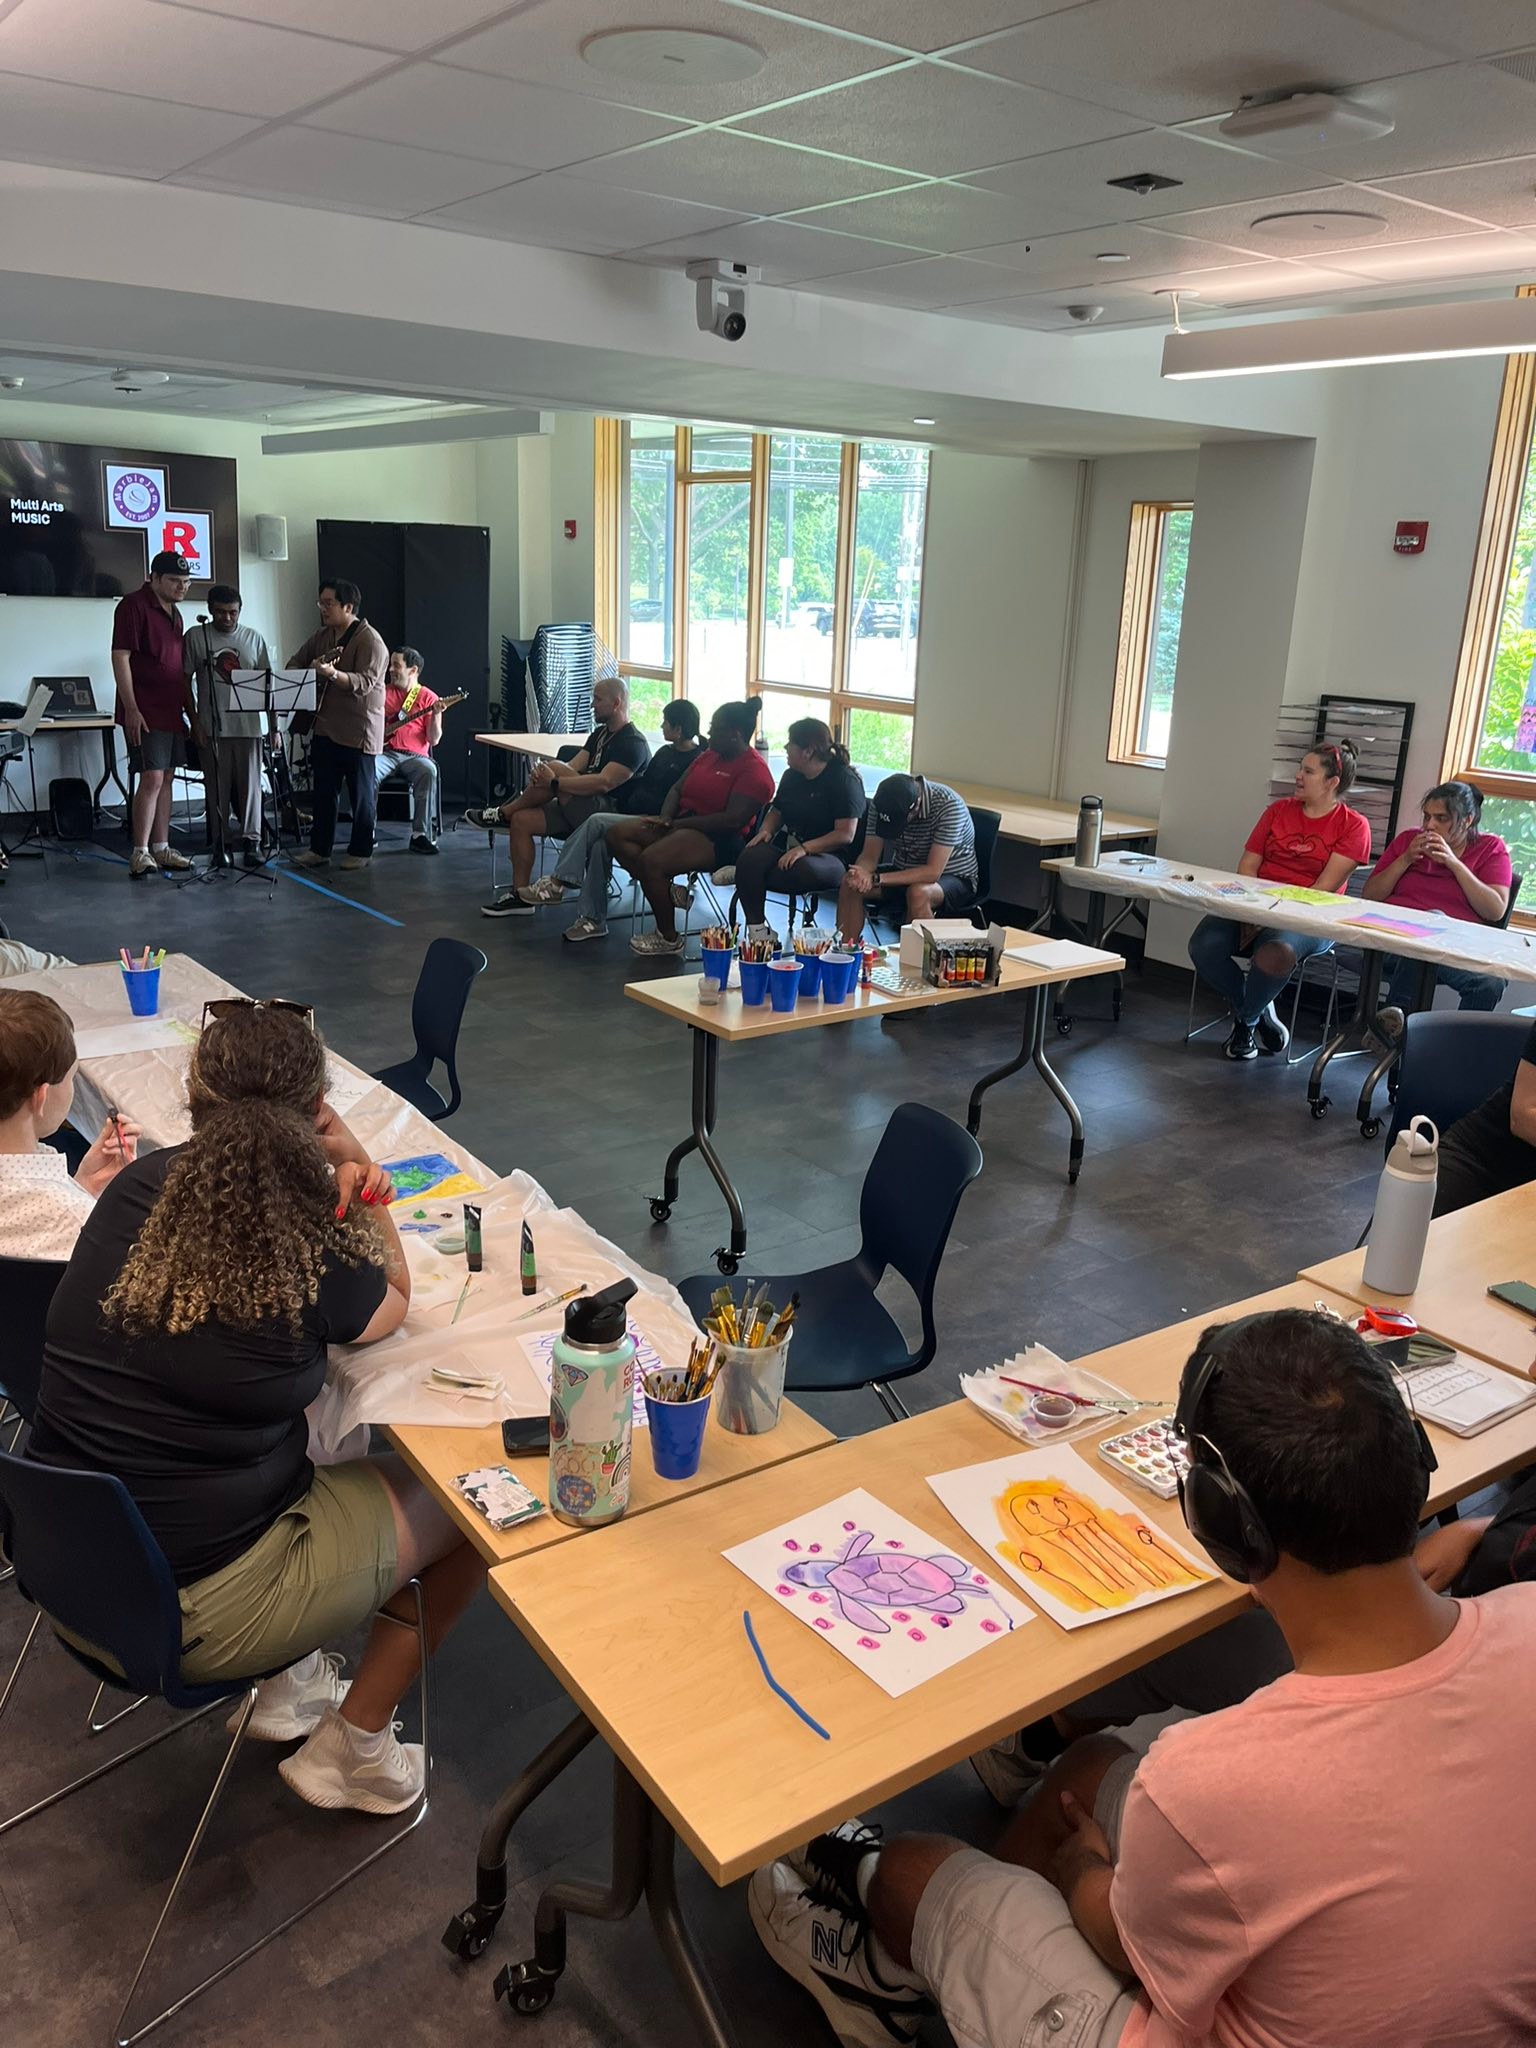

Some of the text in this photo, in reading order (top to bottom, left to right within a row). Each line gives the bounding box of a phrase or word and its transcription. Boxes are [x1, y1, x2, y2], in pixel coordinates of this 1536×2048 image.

[114, 473, 159, 504] MarbleJam
[10, 498, 64, 512] Multi Arts
[11, 511, 50, 524] MUSIC
[162, 520, 200, 559] R
[583, 922, 594, 932] N
[812, 1920, 838, 1970] N
